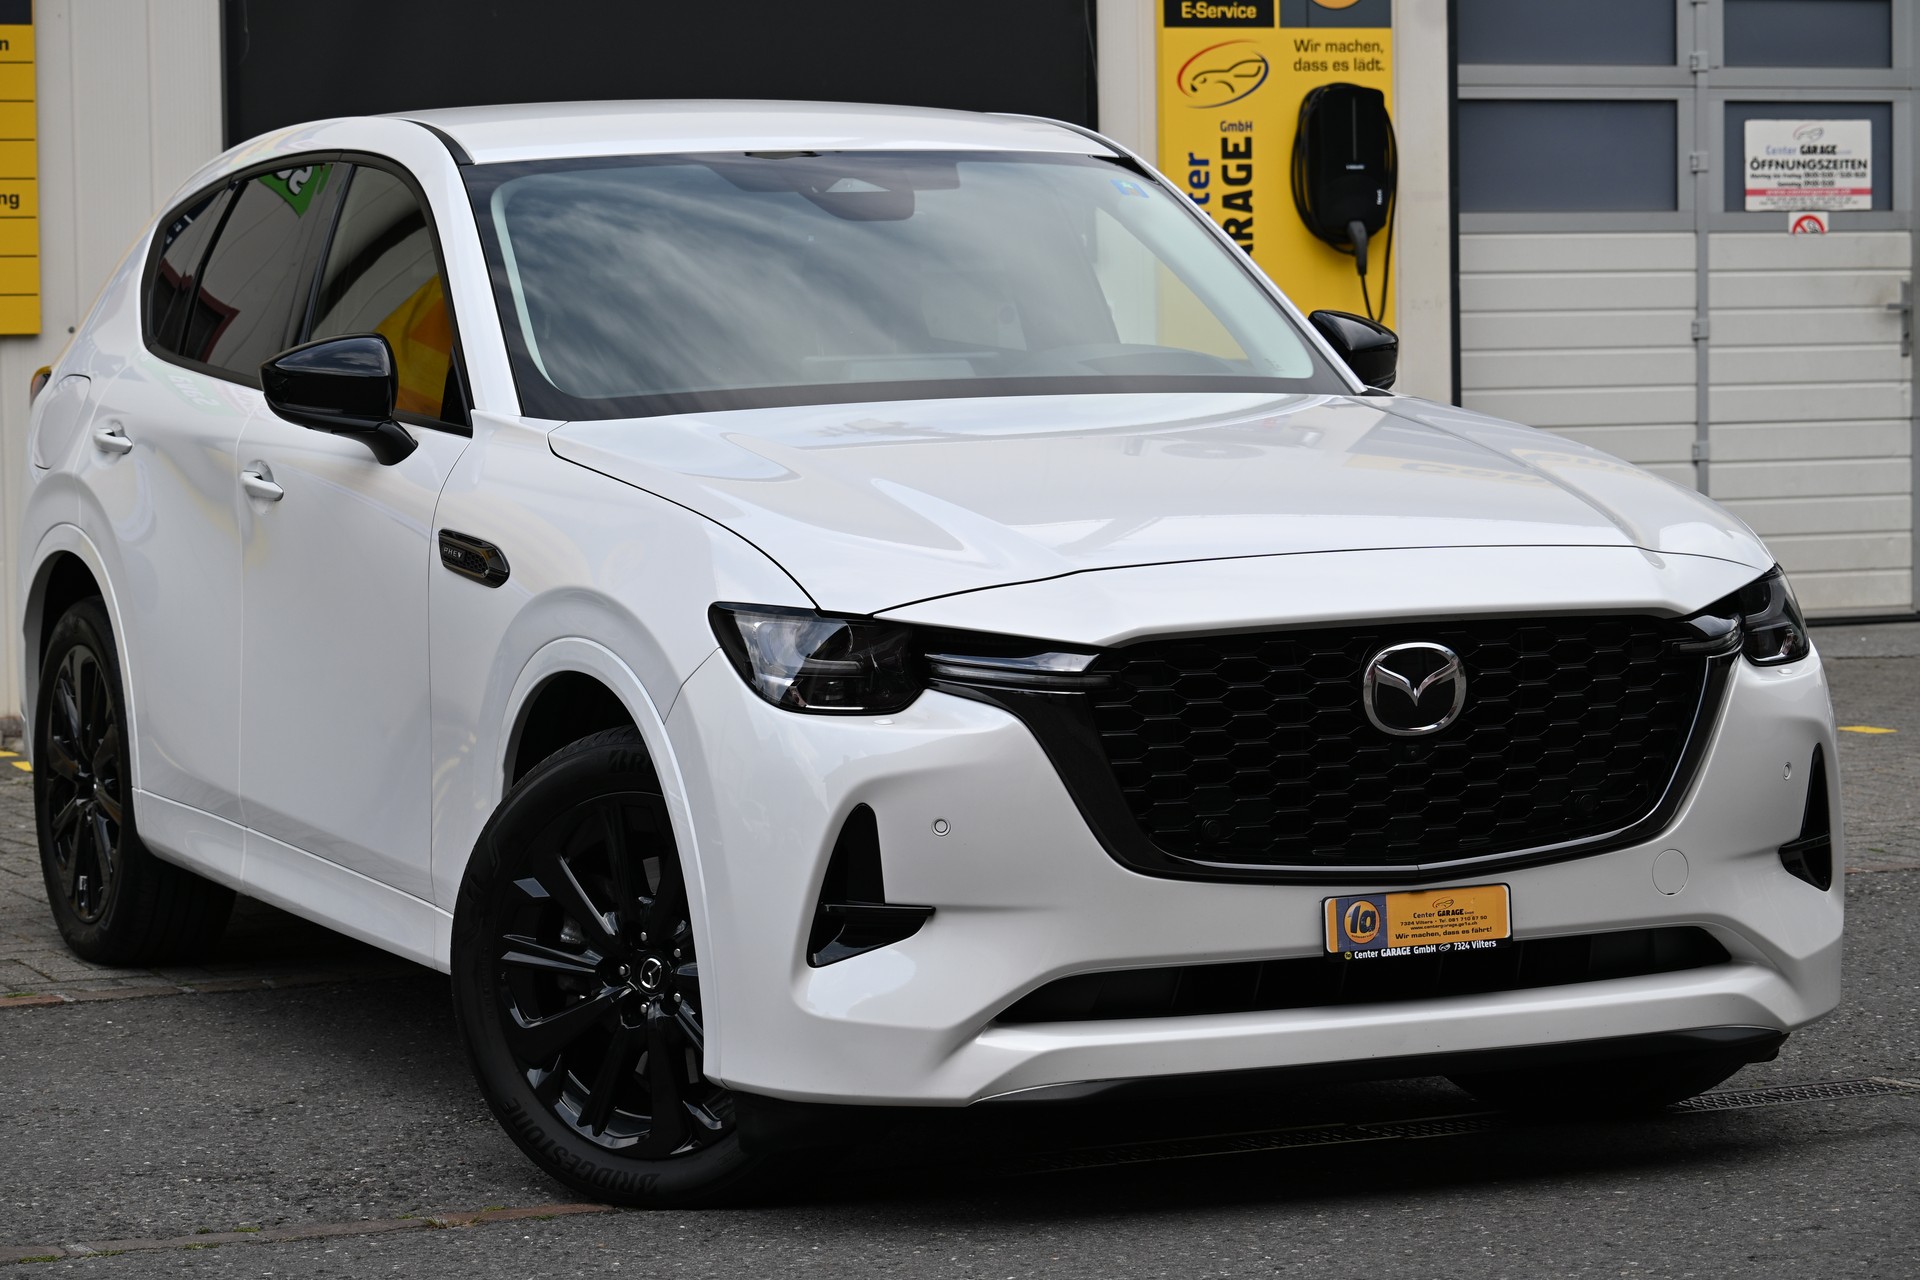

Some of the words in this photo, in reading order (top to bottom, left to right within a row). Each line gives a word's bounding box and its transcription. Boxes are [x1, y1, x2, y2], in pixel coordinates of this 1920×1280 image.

[1181, 2, 1257, 19] E-Service
[1294, 39, 1320, 52] Wir
[1325, 38, 1384, 54] machen,
[1293, 57, 1328, 72] dass
[1332, 59, 1349, 72] es
[1353, 57, 1385, 72] lädt.
[1219, 120, 1253, 133] GmbH
[1750, 156, 1868, 171] ÖFFNUNGSZEITEN
[1188, 152, 1210, 217] ter
[1221, 136, 1254, 257] RAGE
[1437, 908, 1465, 917] GARAGE
[1354, 950, 1378, 959] Center
[1381, 947, 1411, 957] GARAGE
[1413, 944, 1436, 954] GmbH
[1453, 942, 1470, 951] 7324
[1471, 940, 1497, 949] Vilters
